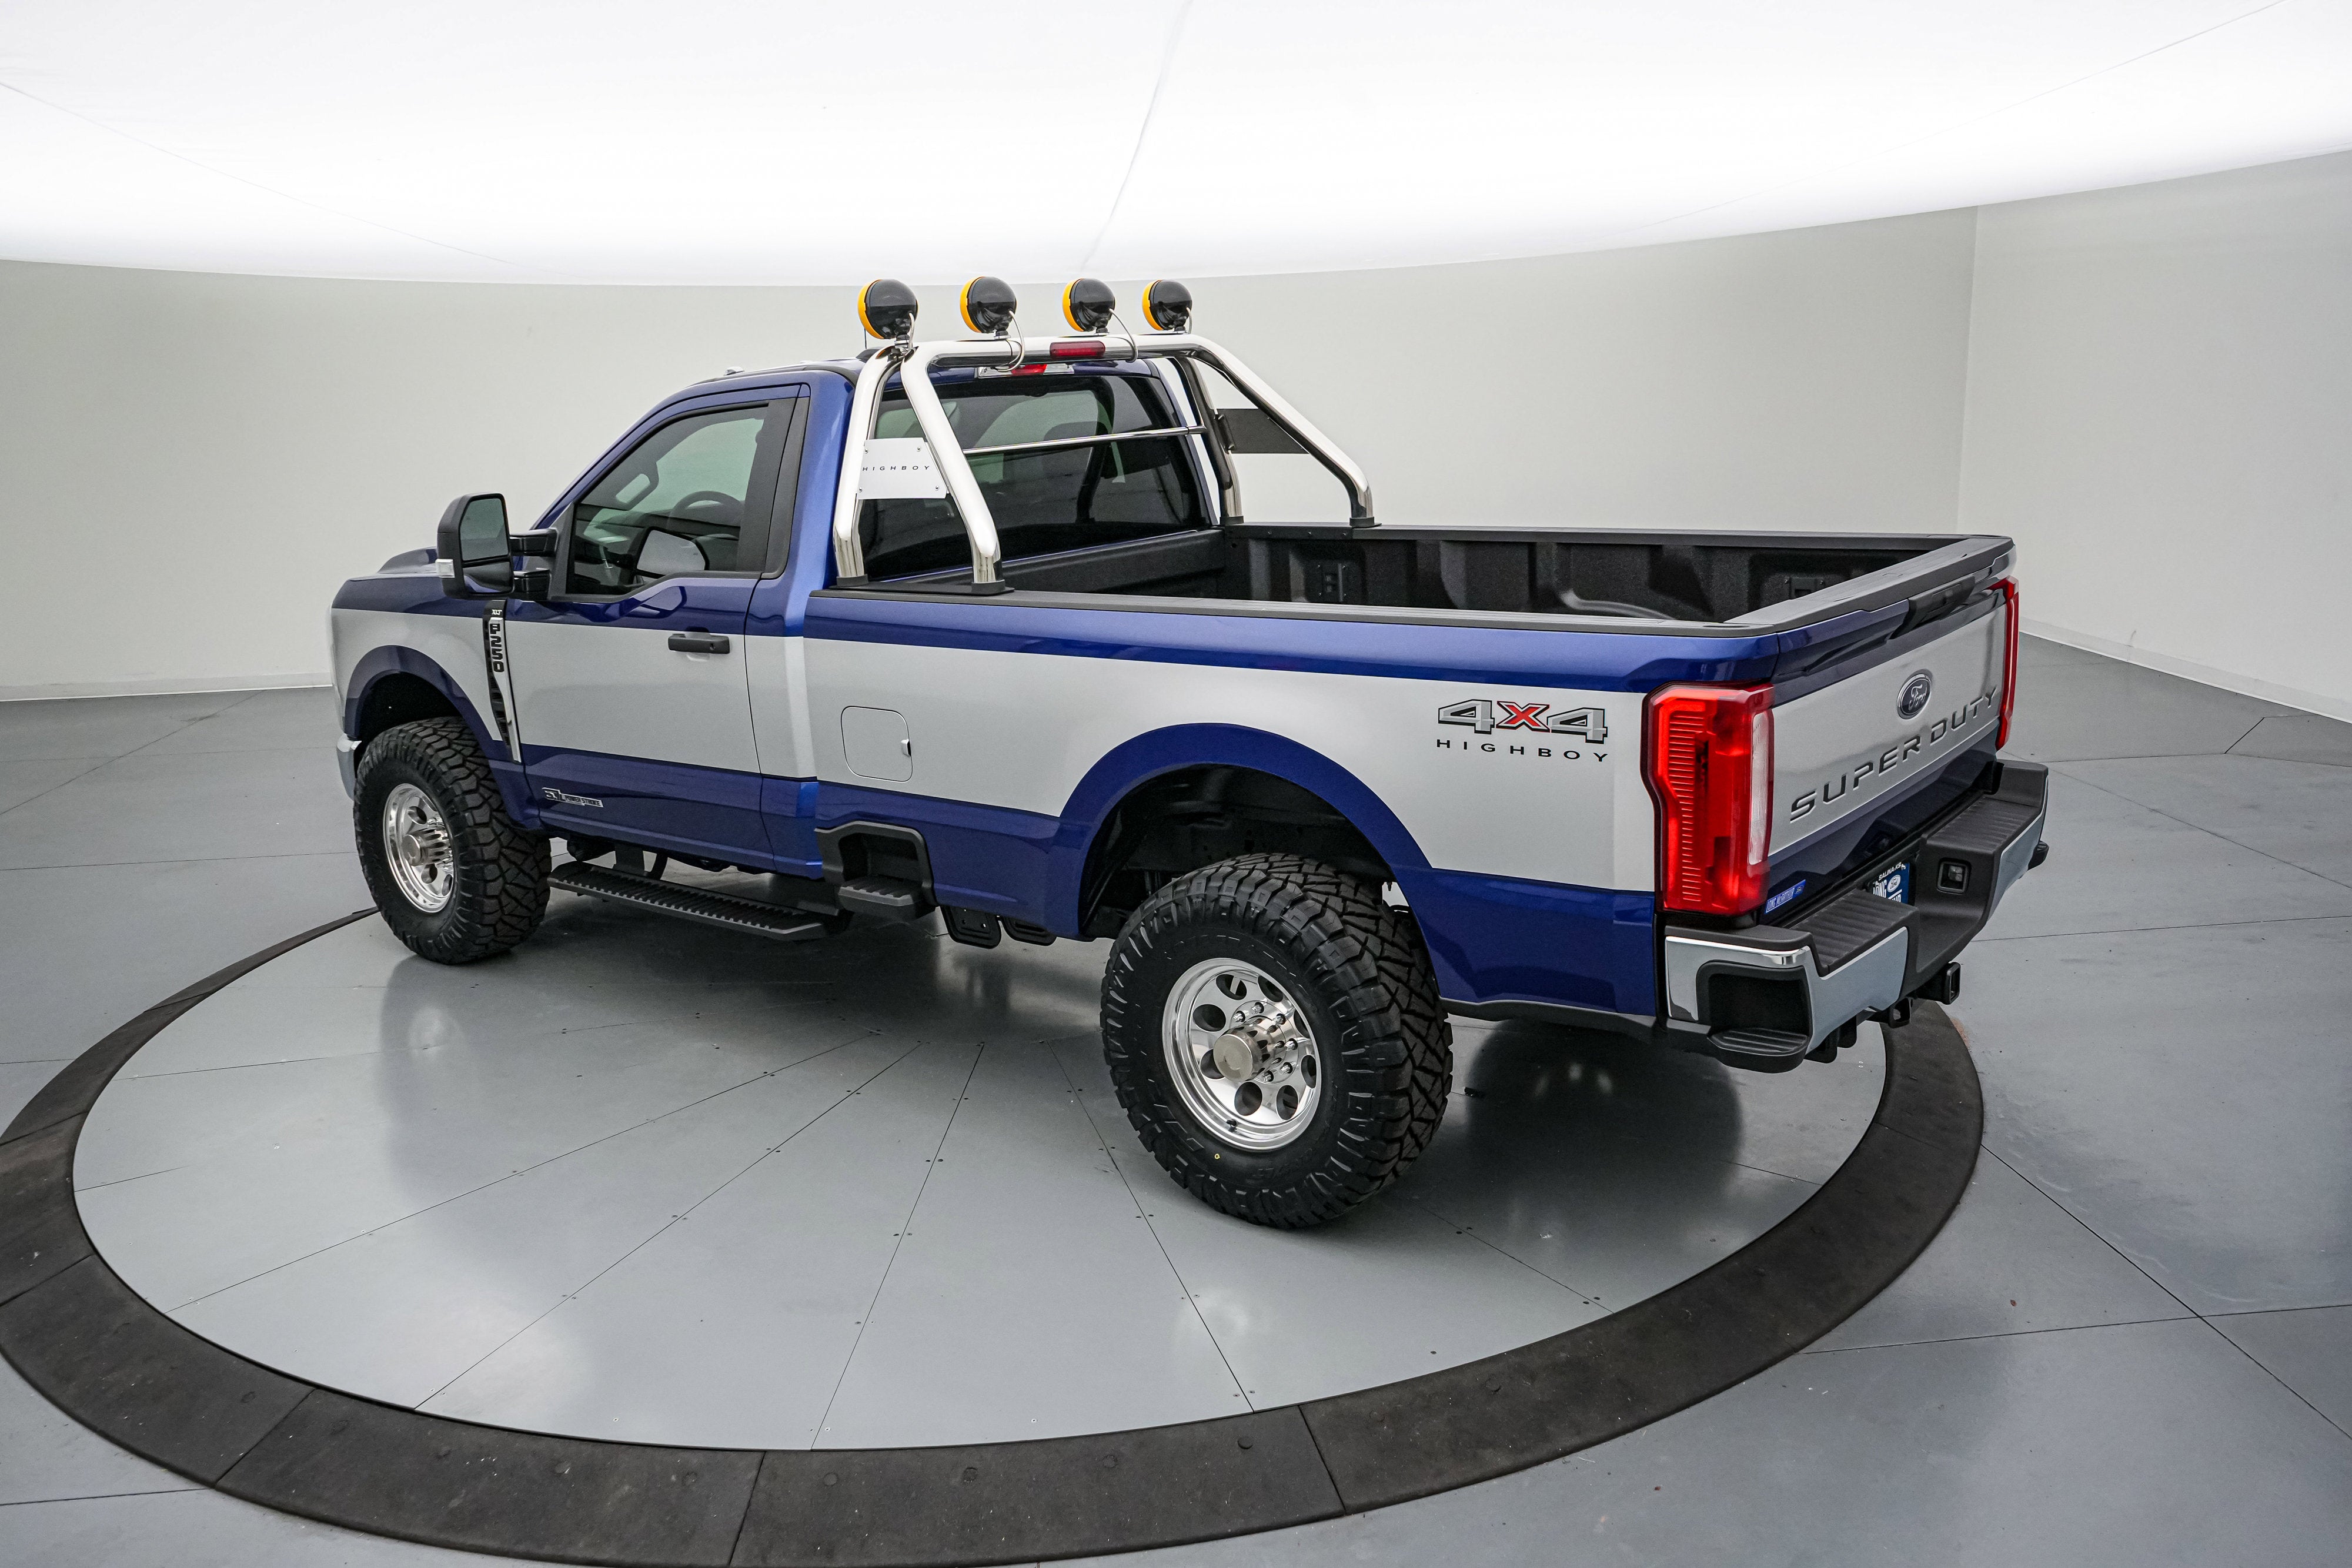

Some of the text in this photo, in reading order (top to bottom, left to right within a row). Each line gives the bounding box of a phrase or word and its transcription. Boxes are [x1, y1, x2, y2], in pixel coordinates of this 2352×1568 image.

[1436, 738, 1608, 763] HIGHBOY
[1790, 685, 1998, 823] SUPER DUTY
